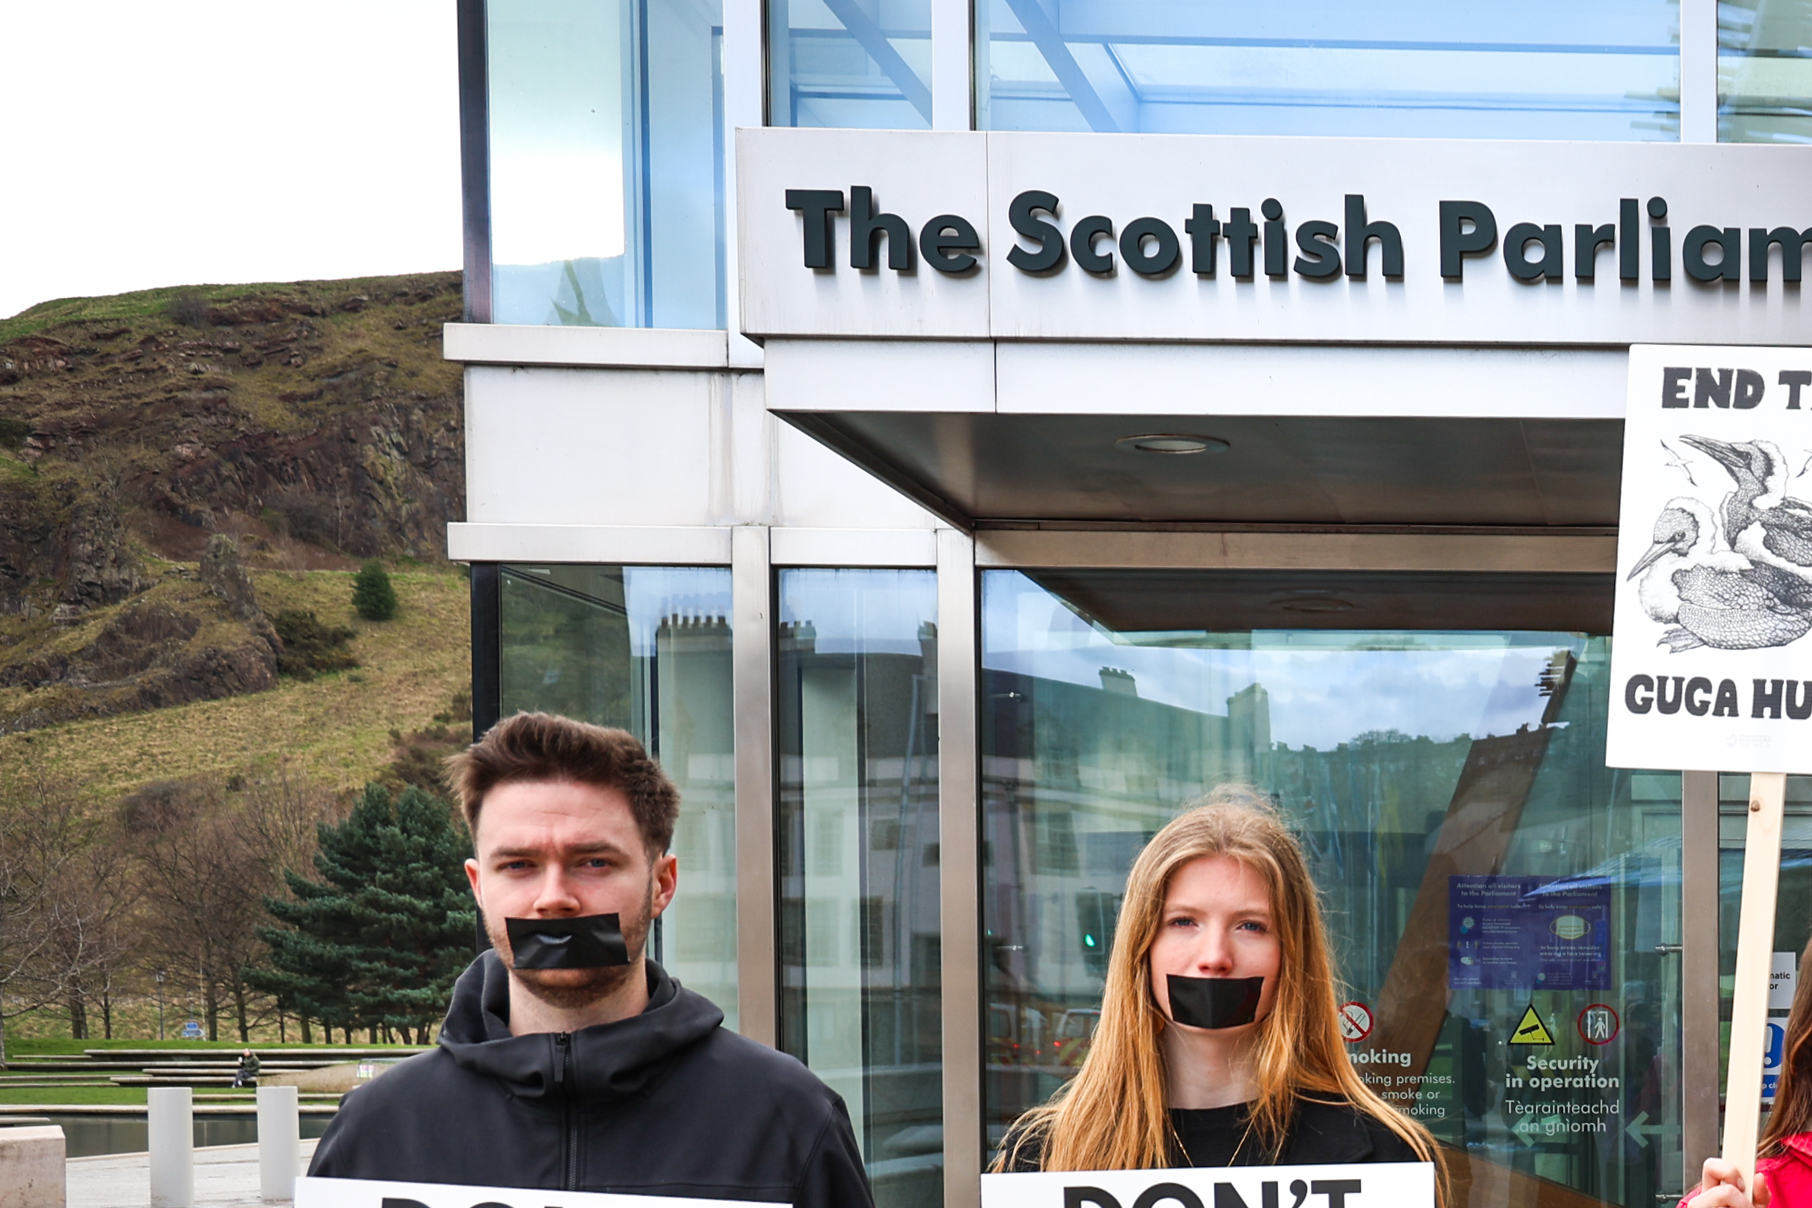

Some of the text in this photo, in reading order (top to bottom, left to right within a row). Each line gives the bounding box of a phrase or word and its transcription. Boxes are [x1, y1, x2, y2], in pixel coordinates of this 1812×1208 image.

[785, 185, 980, 273] The
[1006, 190, 1403, 277] Scottish
[1661, 366, 1766, 410] END
[1624, 673, 1740, 718] GUGA
[1348, 1048, 1412, 1068] moking
[1526, 1055, 1600, 1074] Security
[1360, 1072, 1456, 1087] oking premises.
[1505, 1073, 1620, 1092] in operation
[1381, 1088, 1440, 1100] smoke or
[1505, 1099, 1620, 1115] Tèarainteachd
[1519, 1117, 1607, 1137] an gnìomh
